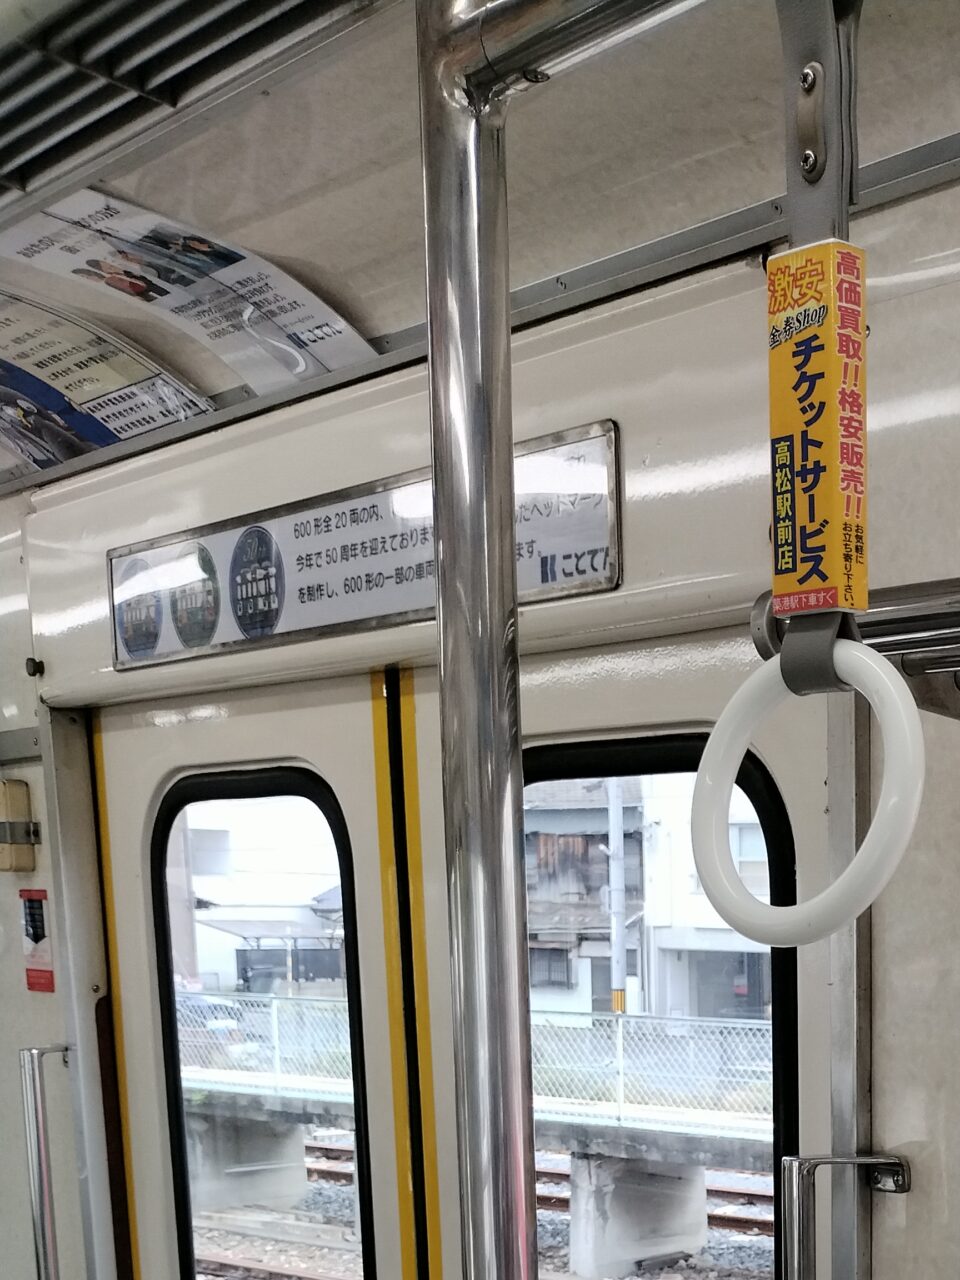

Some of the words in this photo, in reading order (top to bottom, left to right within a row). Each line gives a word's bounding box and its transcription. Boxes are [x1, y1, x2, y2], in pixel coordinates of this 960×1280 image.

[768, 259, 825, 315] 激安
[775, 441, 793, 570] 高松駅前店
[792, 334, 829, 586] チケットサービス
[855, 523, 864, 565] お気軽に
